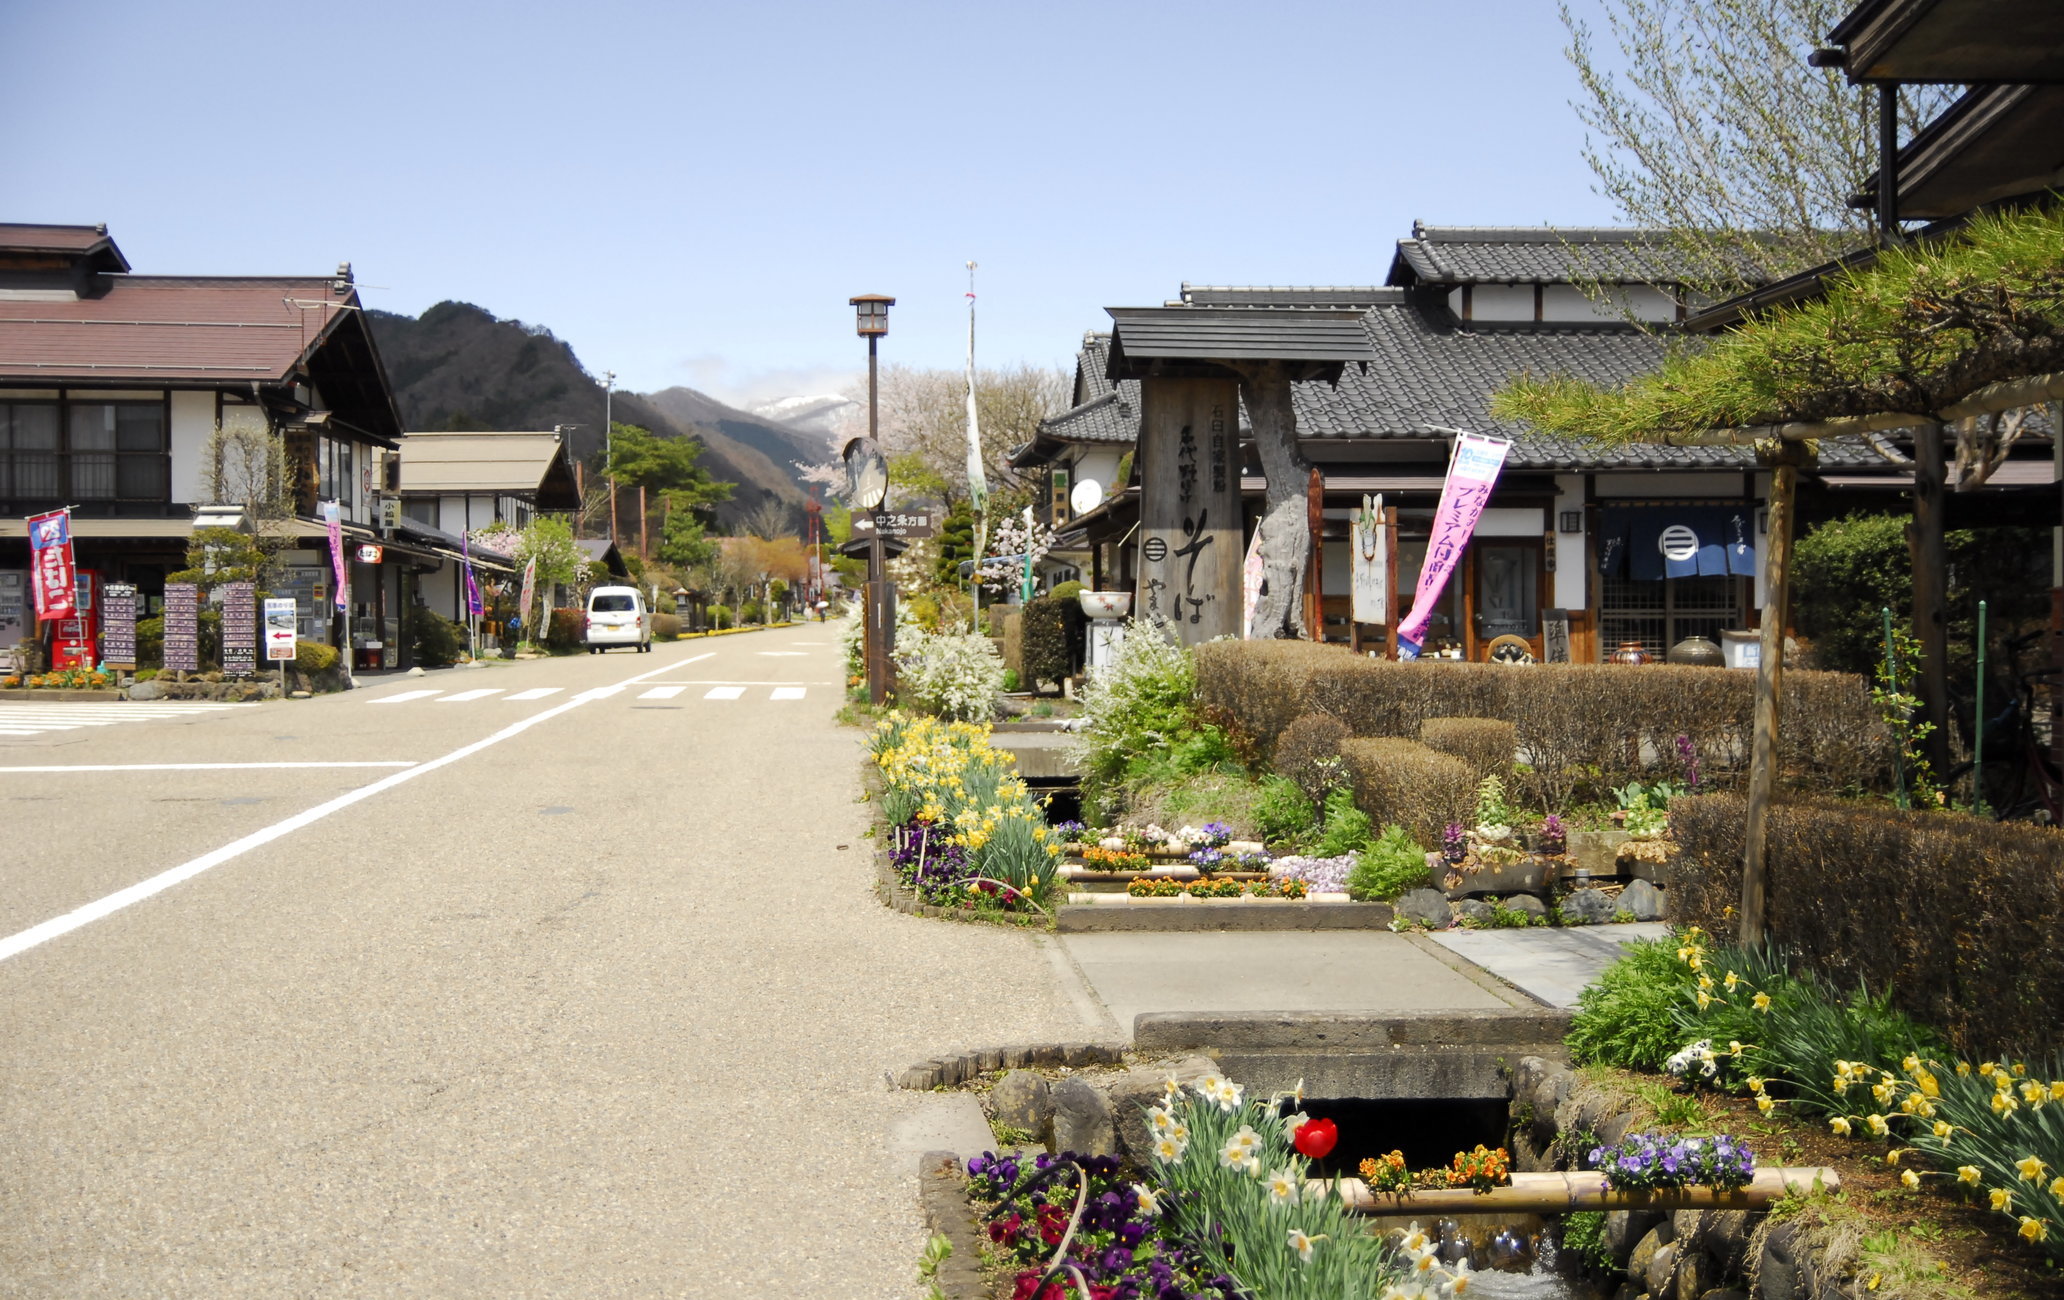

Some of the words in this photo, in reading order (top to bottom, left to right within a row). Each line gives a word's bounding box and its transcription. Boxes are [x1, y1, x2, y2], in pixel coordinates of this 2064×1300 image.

[875, 514, 927, 527] 中之条方面
[44, 546, 68, 610] たばこ
[1173, 508, 1215, 624] そば
